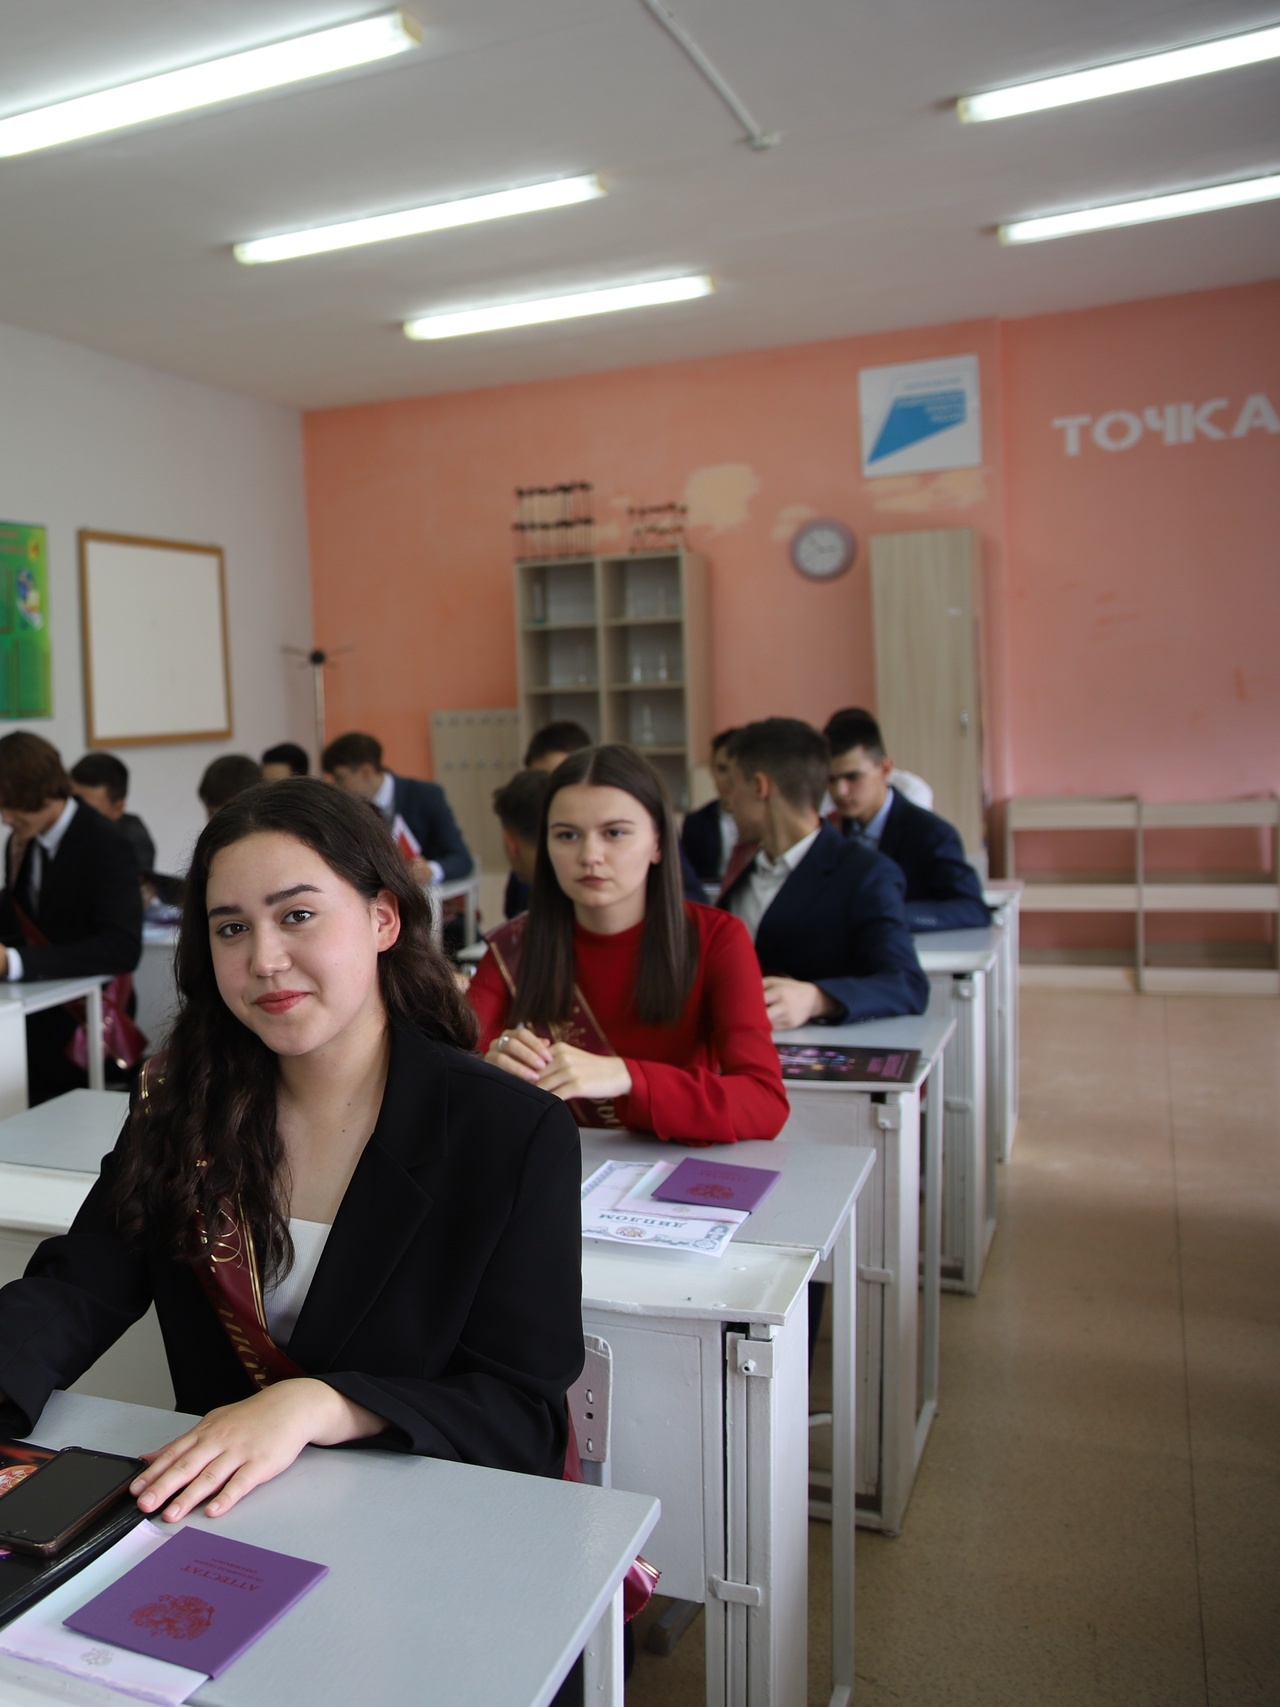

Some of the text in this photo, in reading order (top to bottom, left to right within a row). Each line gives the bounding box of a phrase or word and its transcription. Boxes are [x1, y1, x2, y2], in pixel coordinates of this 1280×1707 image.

[1051, 392, 1280, 457] ТОЧКА
[599, 1213, 687, 1228] ДИПЛОМ
[181, 1564, 259, 1592] АТТЕСТАТ
